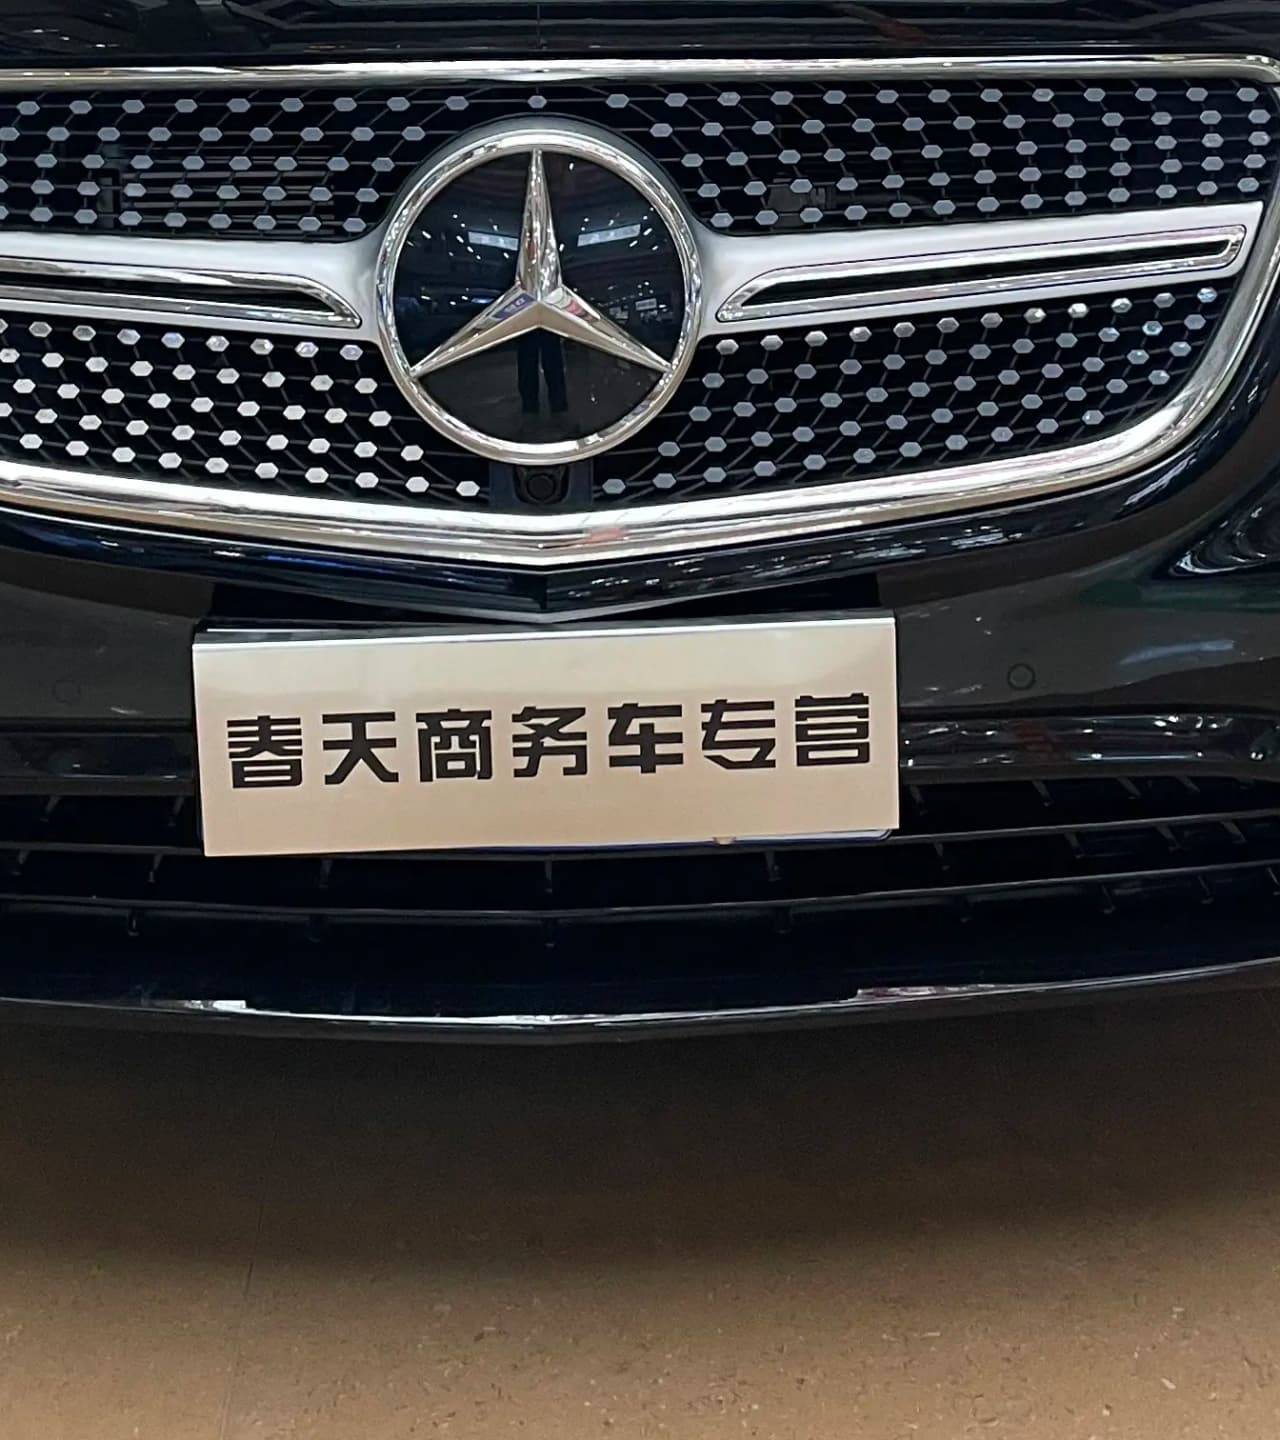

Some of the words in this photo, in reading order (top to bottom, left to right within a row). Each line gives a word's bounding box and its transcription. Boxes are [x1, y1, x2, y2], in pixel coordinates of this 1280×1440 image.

[226, 692, 872, 789] 春天商务车专营
